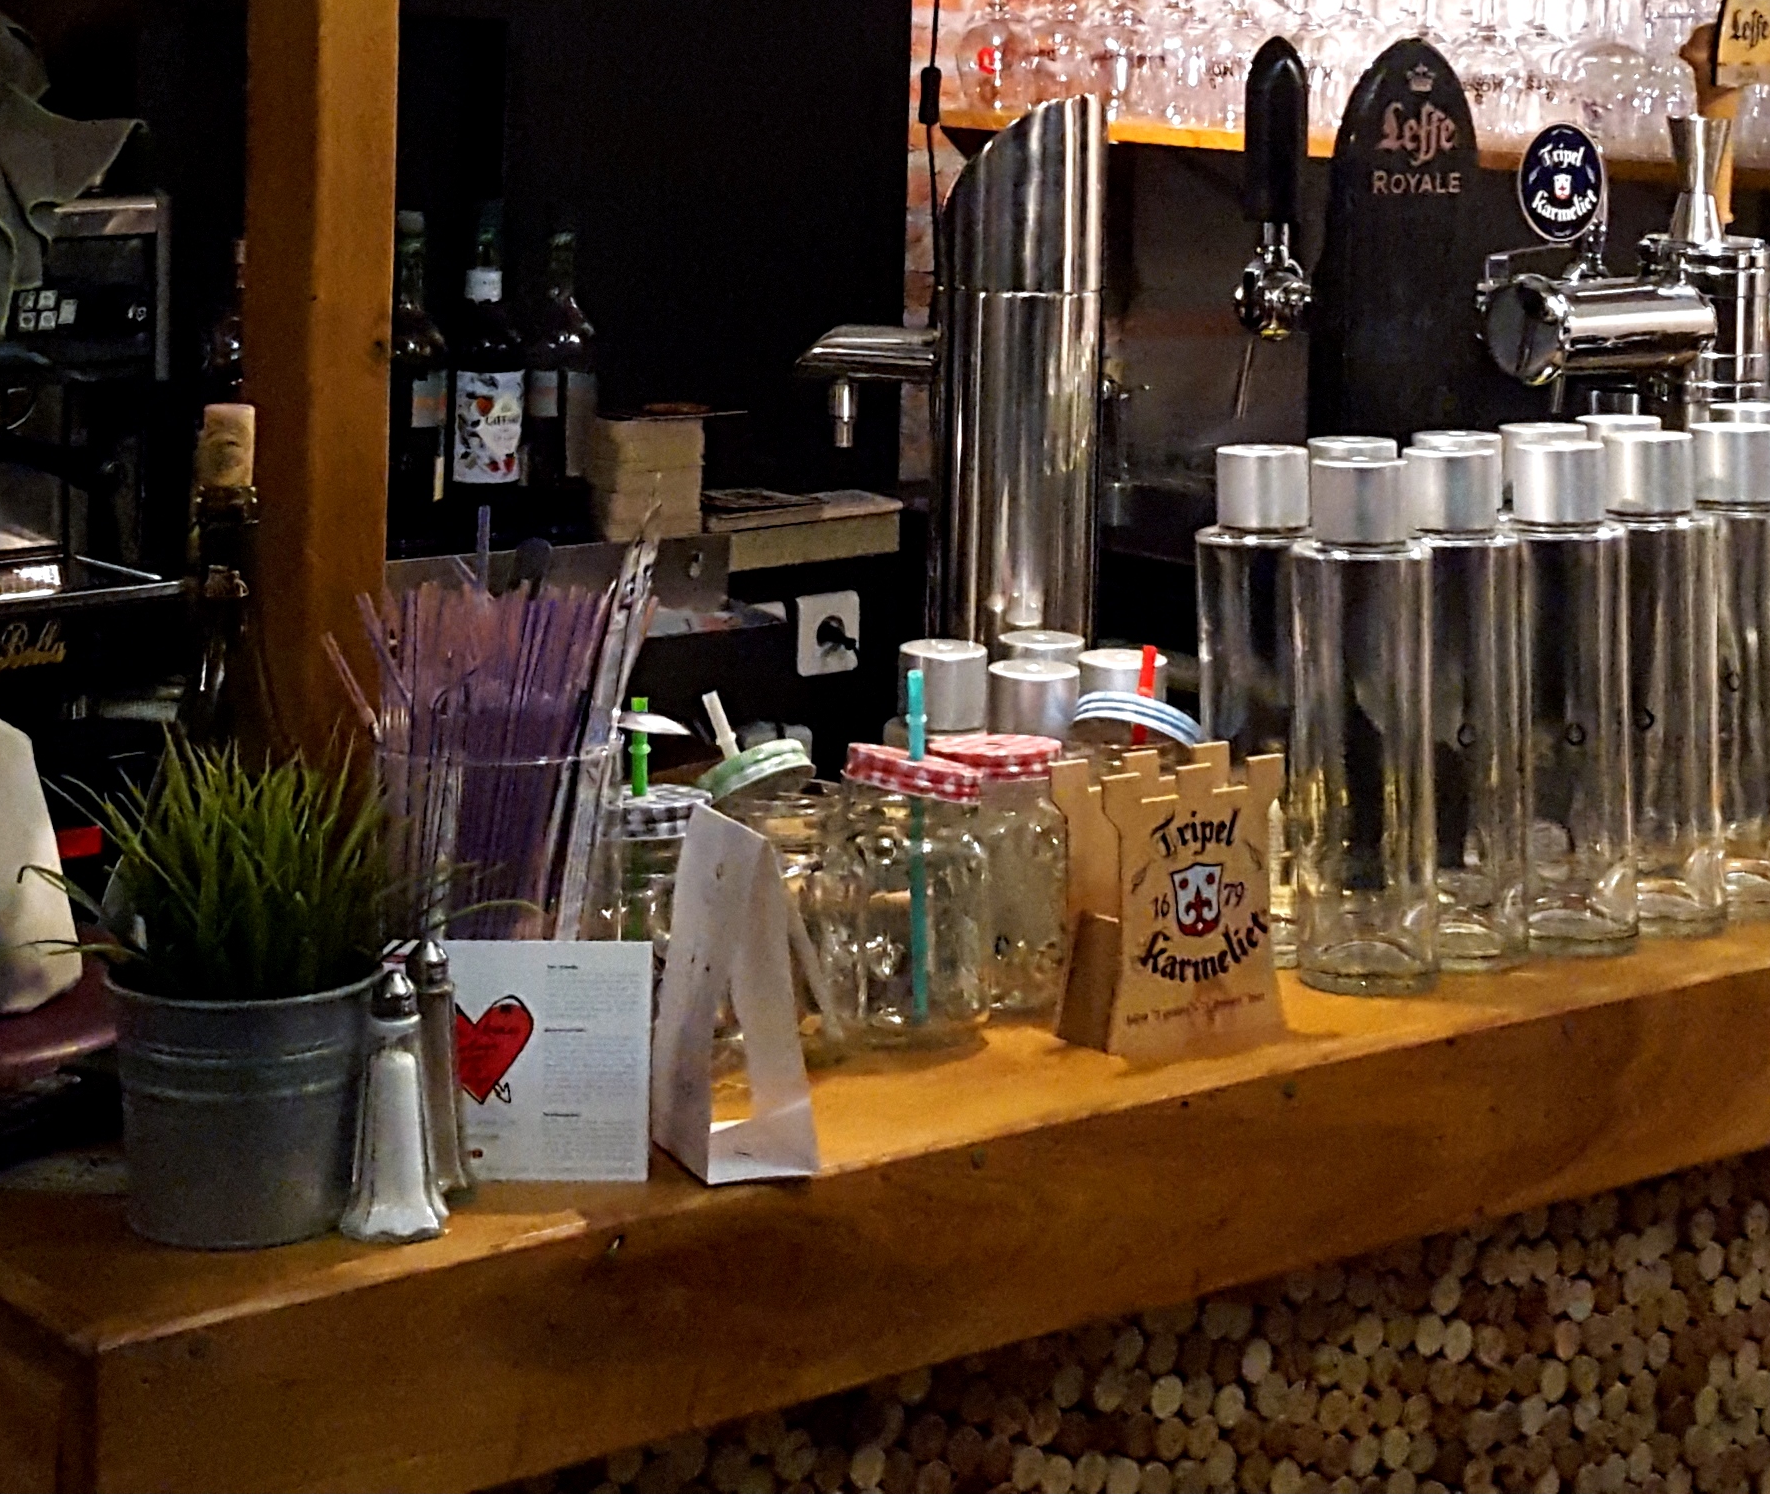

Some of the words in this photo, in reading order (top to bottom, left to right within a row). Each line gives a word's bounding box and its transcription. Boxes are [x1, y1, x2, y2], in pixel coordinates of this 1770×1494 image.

[1729, 9, 1770, 50] Leffe
[1375, 101, 1456, 166] Leffe
[1538, 142, 1586, 169] Tripel
[1372, 170, 1461, 195] ROYALE
[1531, 189, 1598, 223] Karmeliet
[1151, 808, 1241, 857] Tripel
[1153, 893, 1171, 921] 16
[1223, 881, 1246, 908] 79
[1139, 908, 1269, 984] Karmeliet
